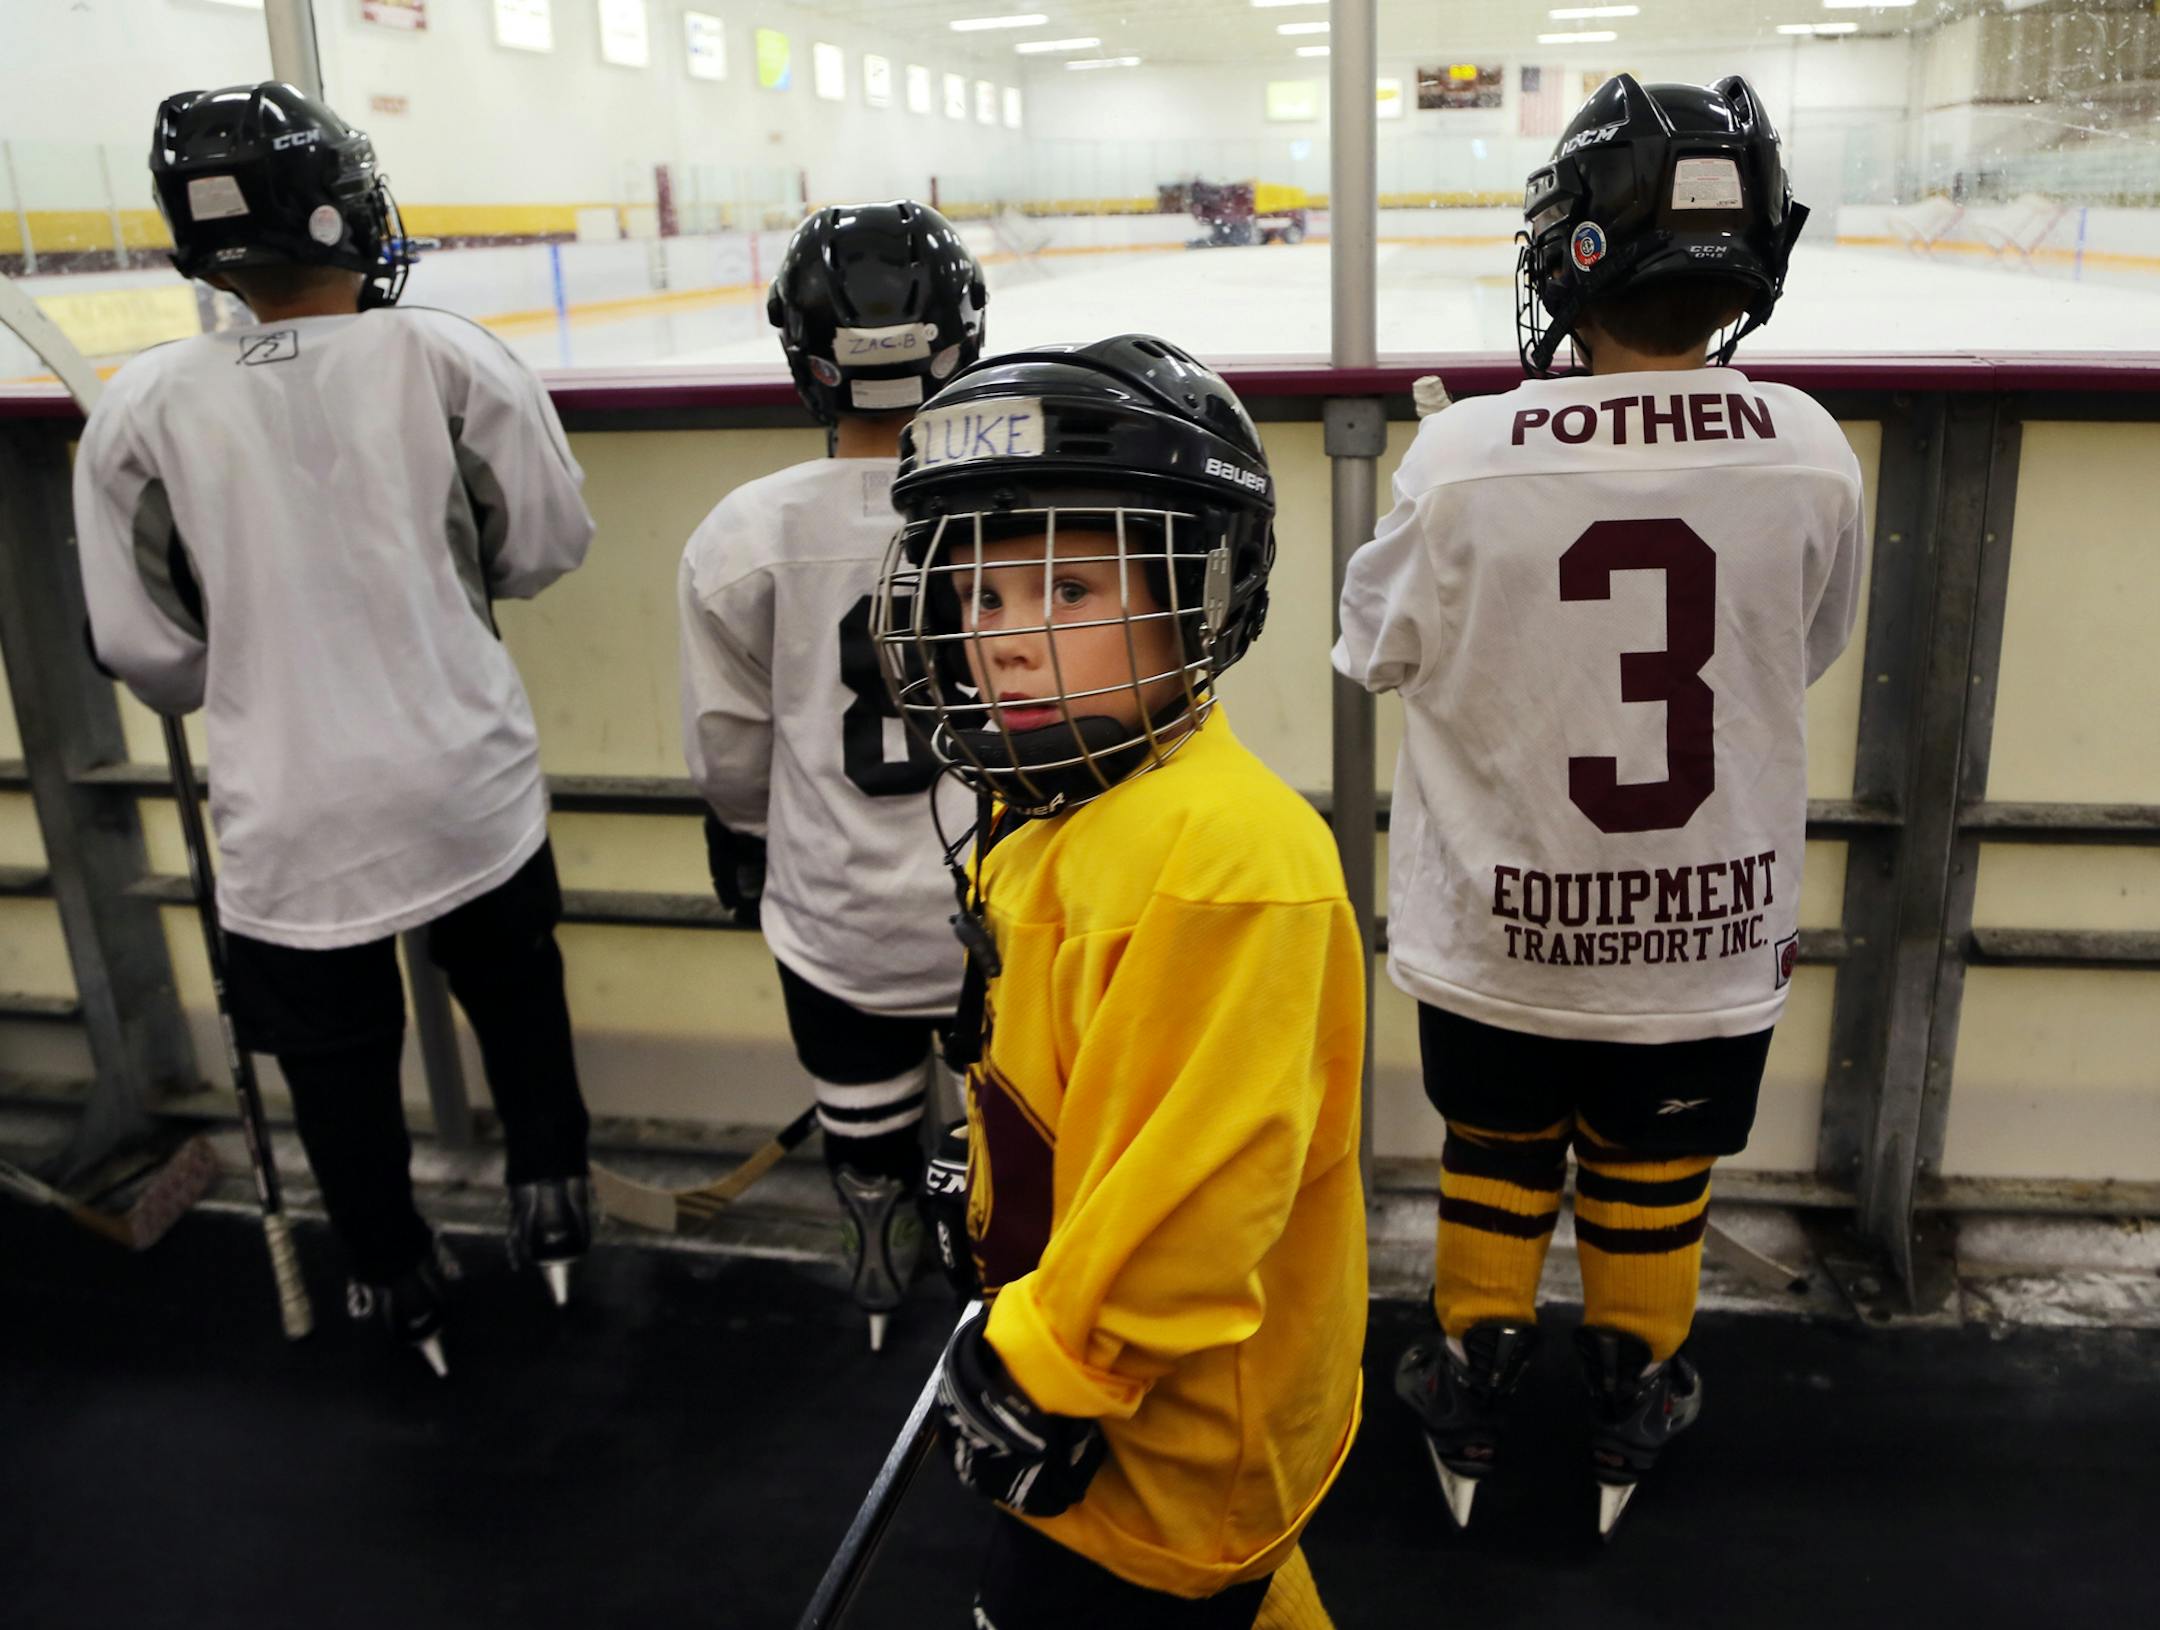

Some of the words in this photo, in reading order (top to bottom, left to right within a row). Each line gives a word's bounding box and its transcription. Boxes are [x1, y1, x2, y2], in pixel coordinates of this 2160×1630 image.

[272, 128, 321, 151] CCM
[1566, 127, 1619, 154] CCM
[924, 414, 1031, 464] LUKE
[1511, 393, 1776, 445] POTHEN
[839, 594, 938, 797] 8
[1558, 518, 1716, 833] 3
[1492, 850, 1776, 929] EQUIPMENT
[1504, 924, 1713, 965] TRANSPORT
[1719, 914, 1769, 958] INC.
